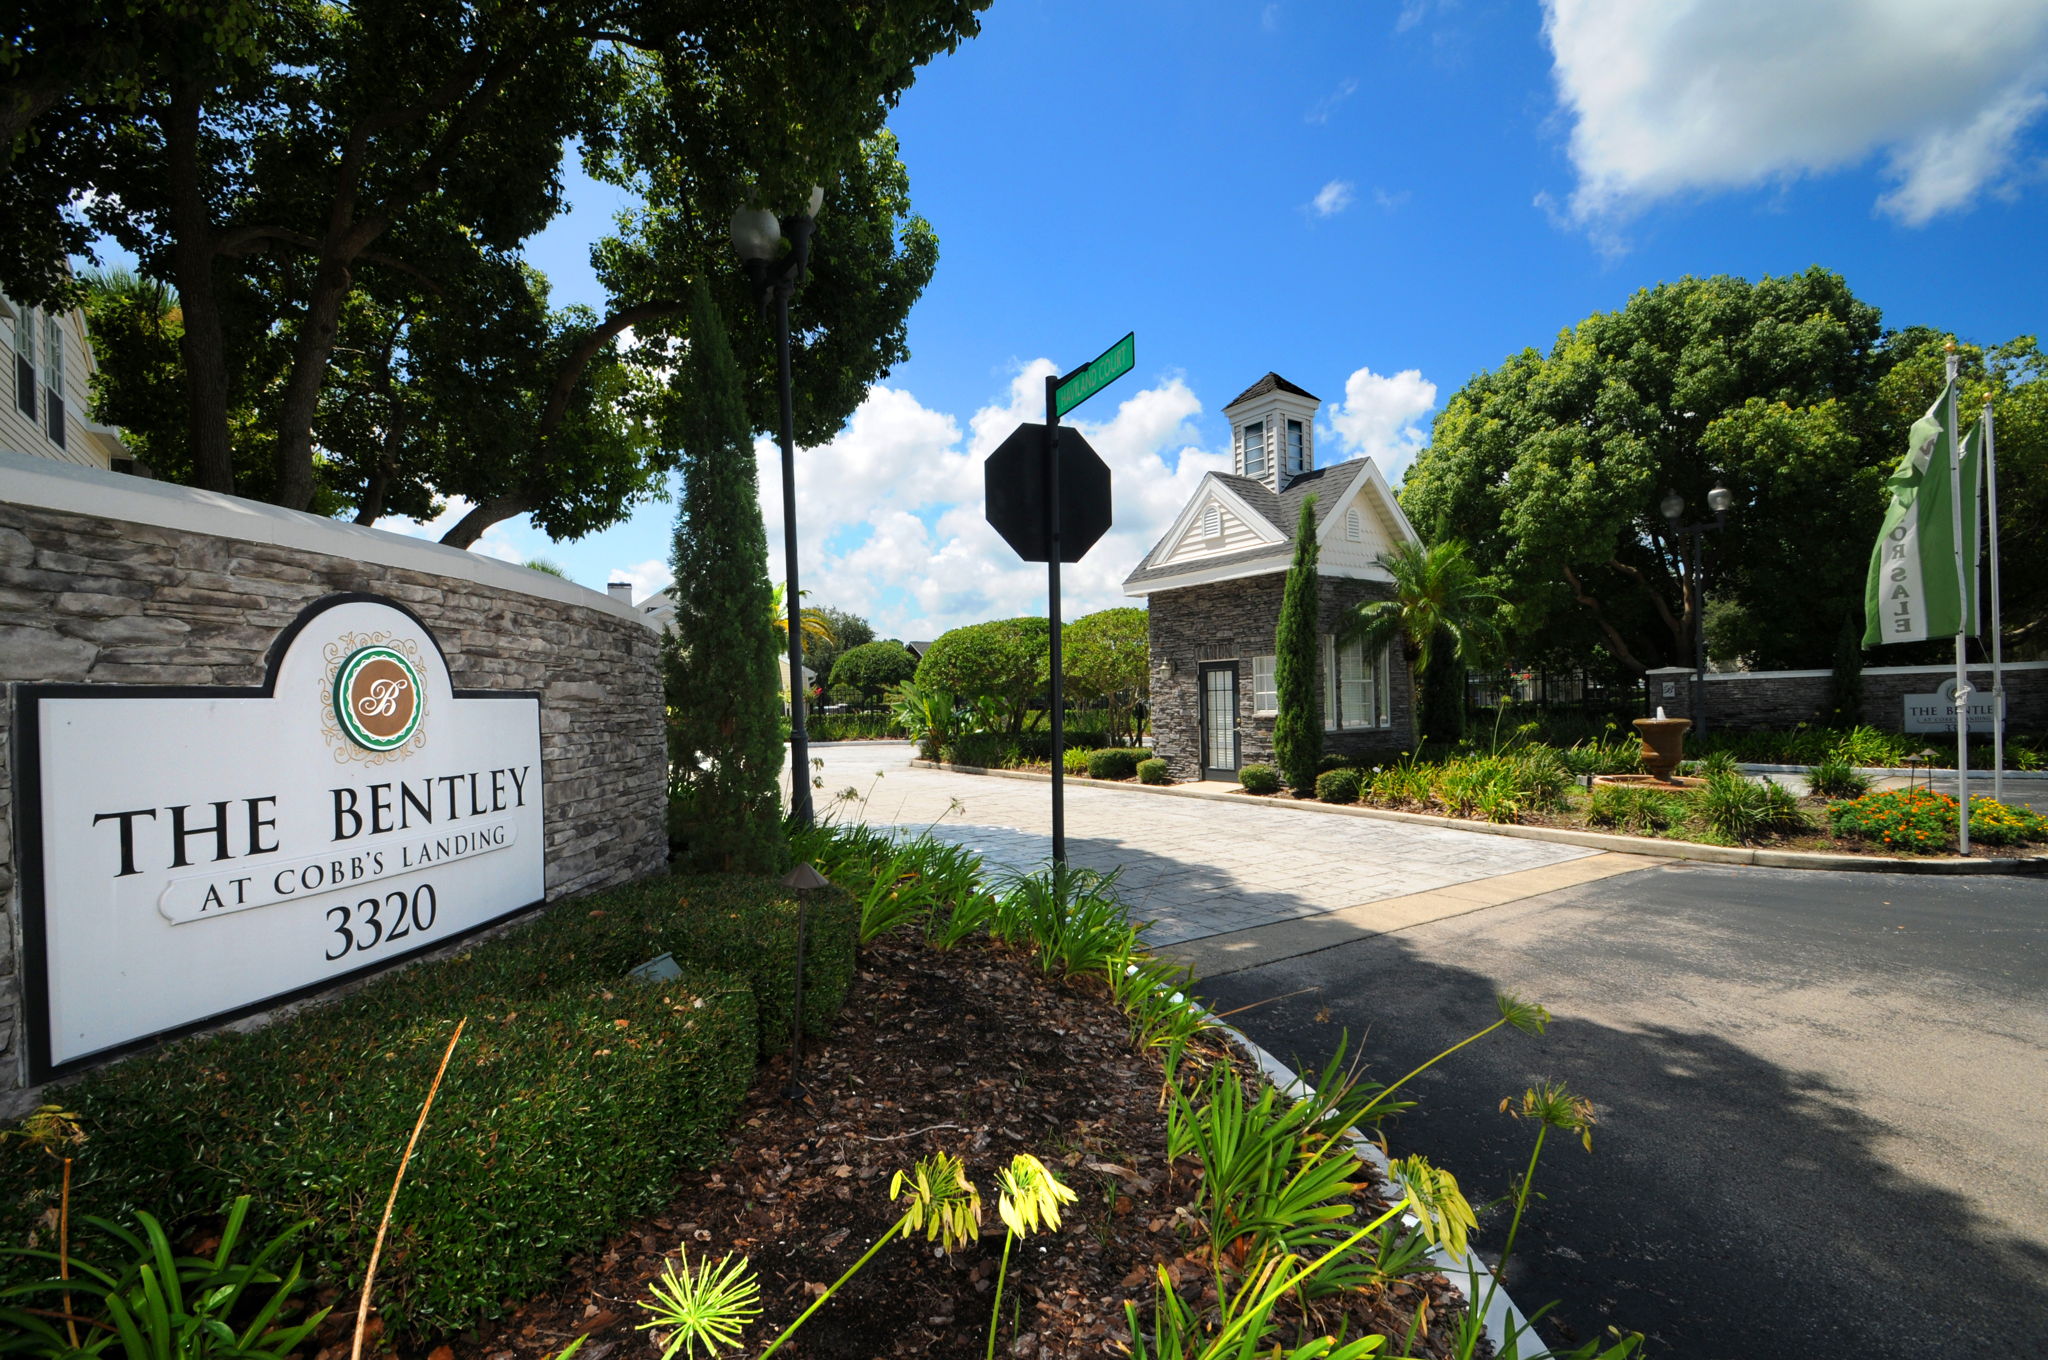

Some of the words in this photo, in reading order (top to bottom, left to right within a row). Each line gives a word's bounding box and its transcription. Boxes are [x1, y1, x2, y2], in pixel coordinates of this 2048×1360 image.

[1099, 345, 1127, 381] COURT
[1910, 706, 1937, 716] THE
[1946, 705, 1993, 715] BENTLE
[92, 795, 280, 879] THE
[329, 765, 531, 843] BENTLEY
[200, 877, 253, 912] AT
[273, 851, 384, 896] COBB'S
[402, 825, 506, 867] LANDING
[325, 883, 437, 961] 3320
